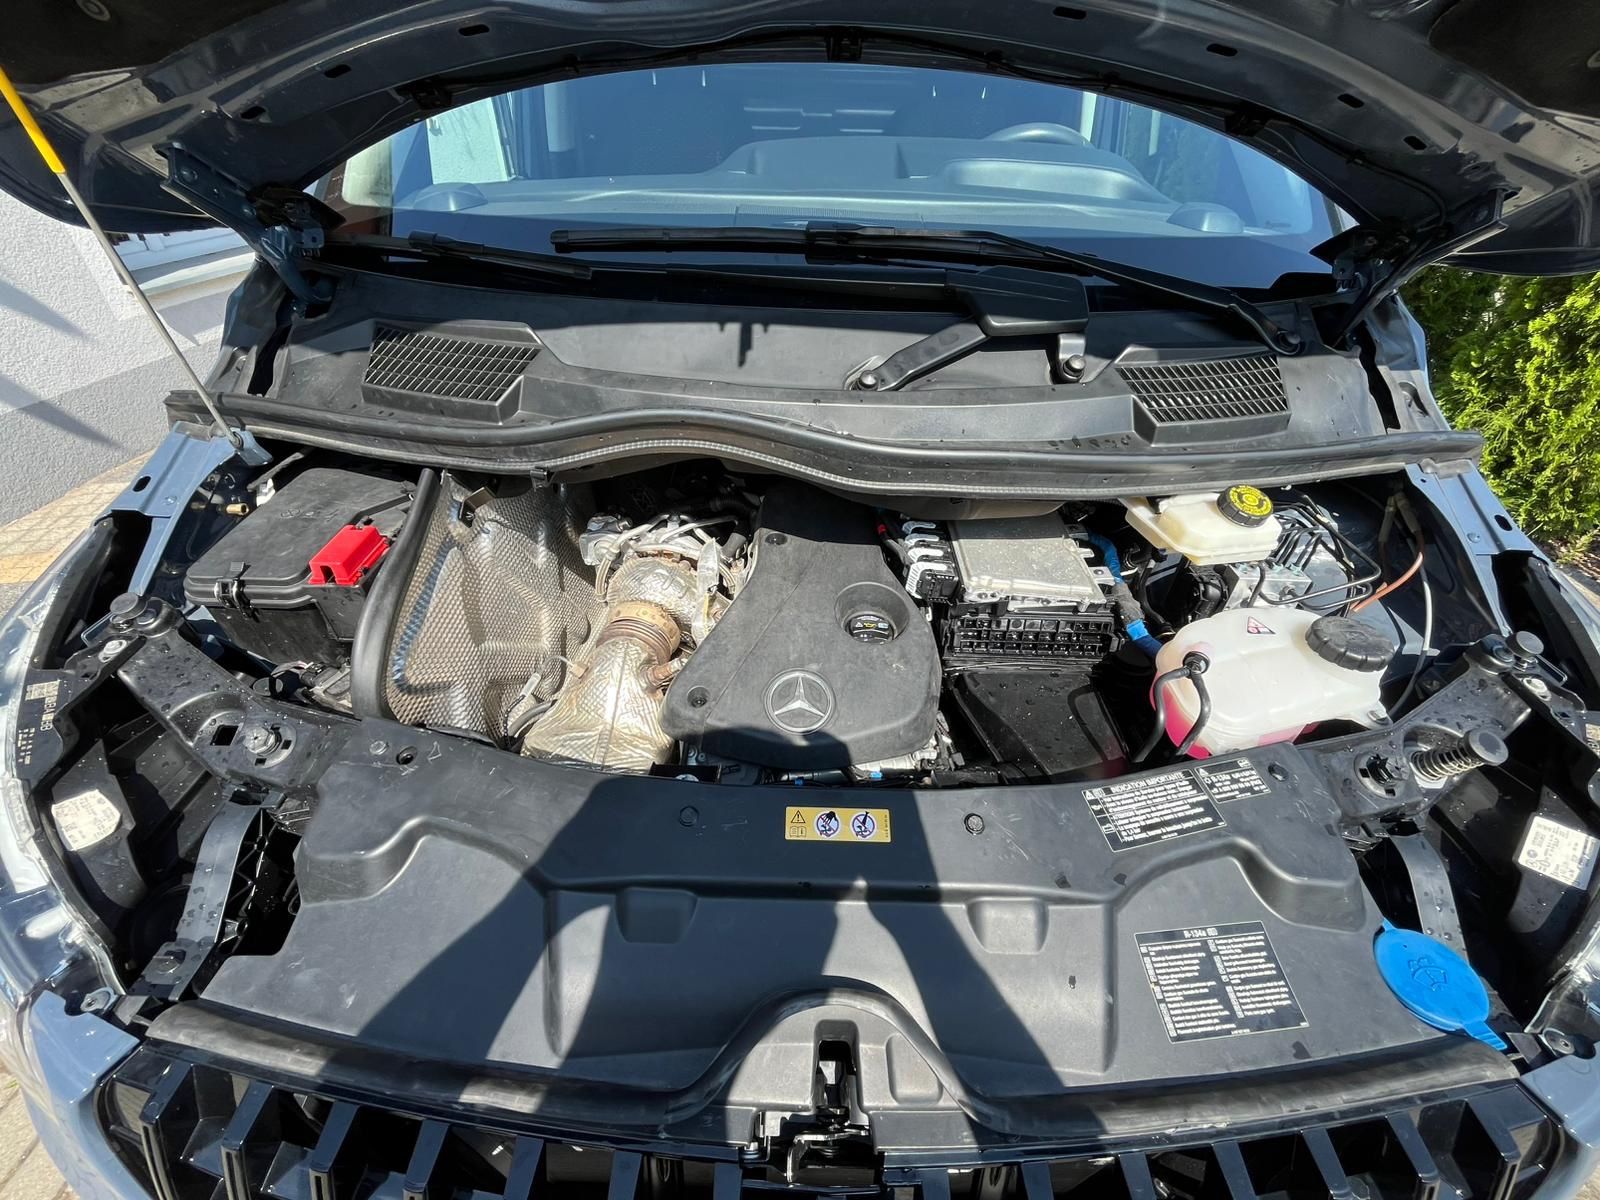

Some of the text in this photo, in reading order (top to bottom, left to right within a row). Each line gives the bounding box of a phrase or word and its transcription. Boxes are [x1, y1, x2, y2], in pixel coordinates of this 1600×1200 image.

[1111, 772, 1185, 793] INDICATION IMPORTANTE
[1184, 929, 1207, 939] R-134a
